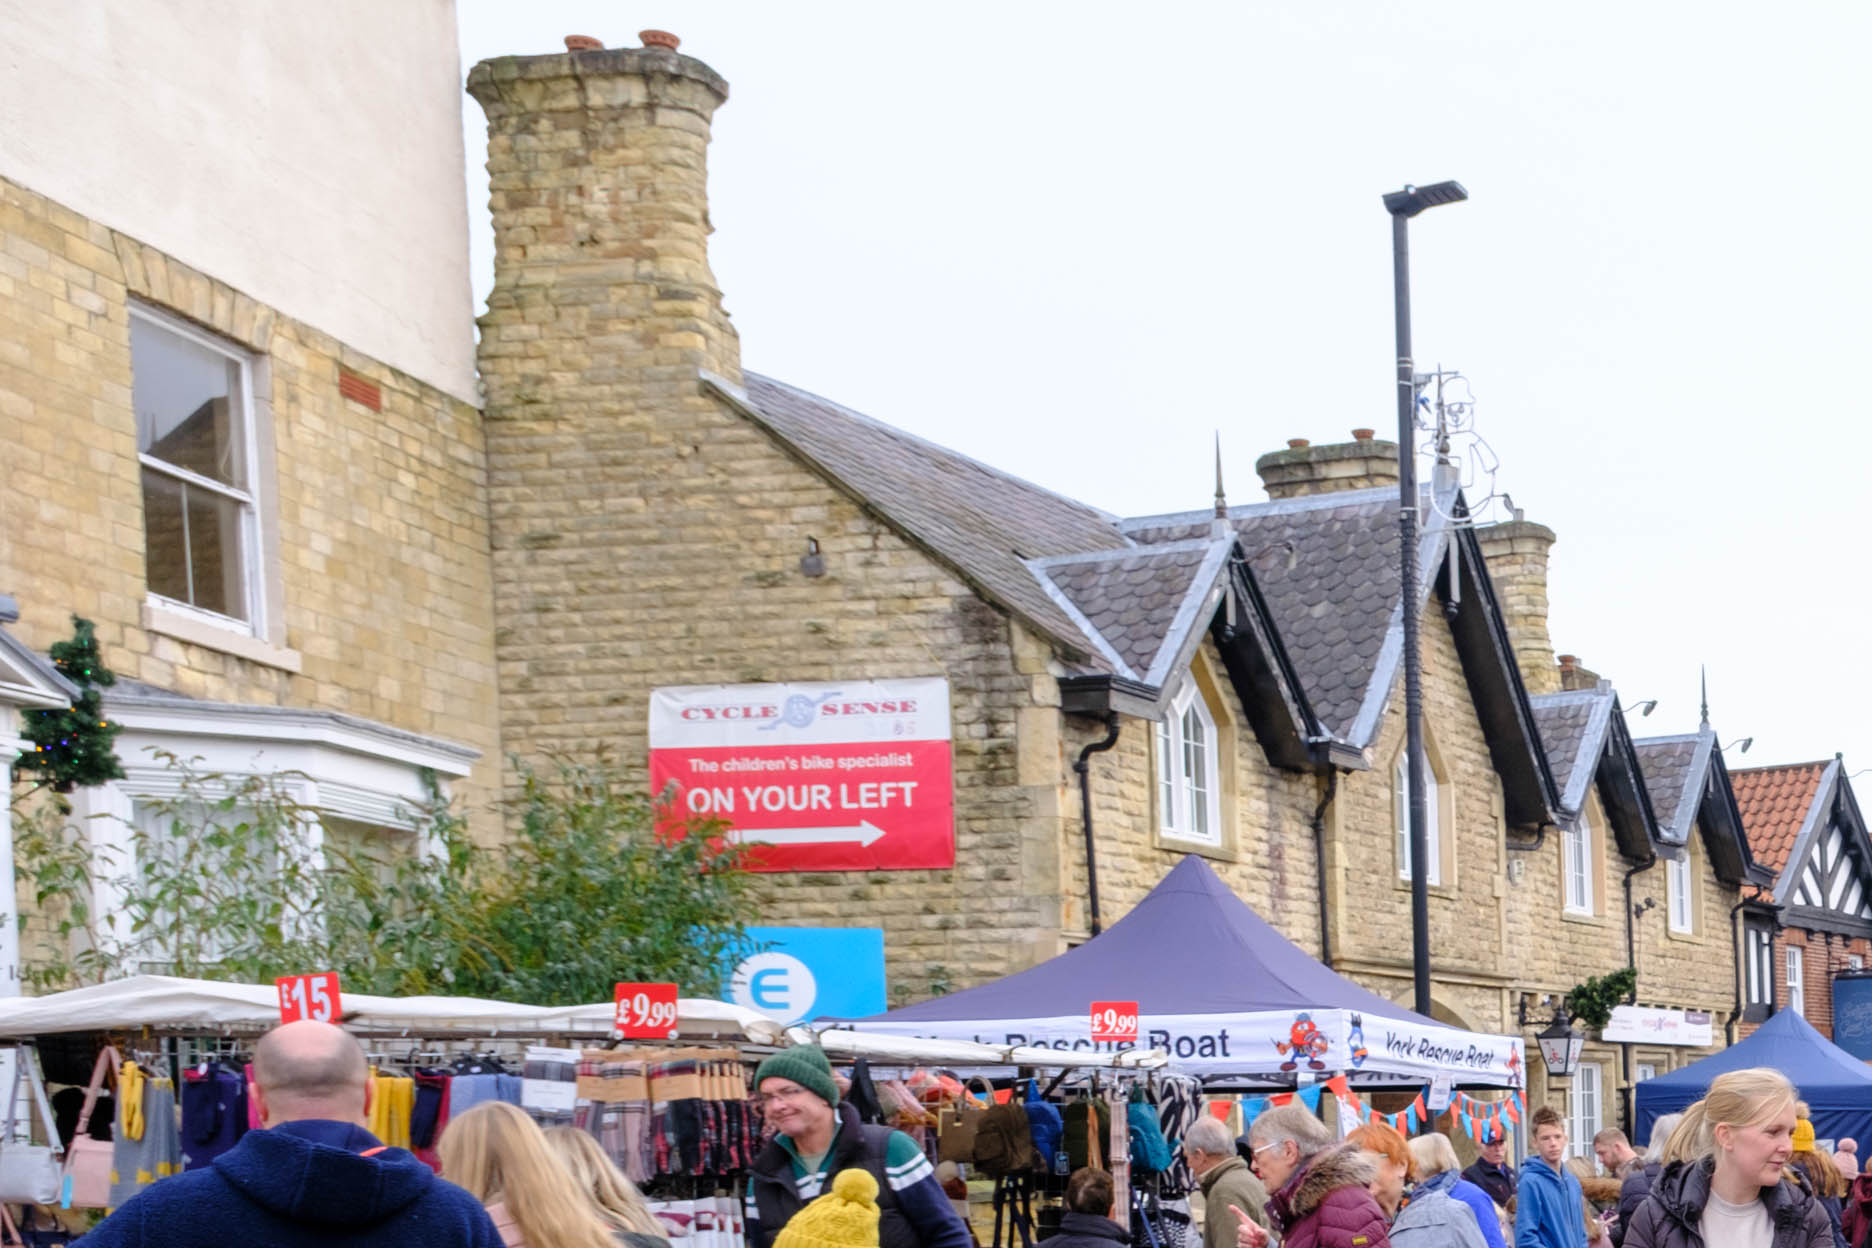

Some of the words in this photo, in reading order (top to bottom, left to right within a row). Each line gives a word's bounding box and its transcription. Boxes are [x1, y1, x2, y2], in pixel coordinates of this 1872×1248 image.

[680, 704, 780, 721] CYCLE
[820, 699, 918, 717] SENSE
[688, 757, 719, 773] The
[721, 756, 799, 772] children's
[801, 754, 835, 770] bike
[837, 752, 913, 771] specialist
[687, 786, 735, 814] ON
[742, 784, 832, 812] YOUR
[840, 781, 918, 809] LEFT
[281, 975, 333, 1023] £15
[614, 992, 677, 1029] £9.99
[1091, 1007, 1138, 1035] £9.99
[1148, 1028, 1231, 1059] Boat
